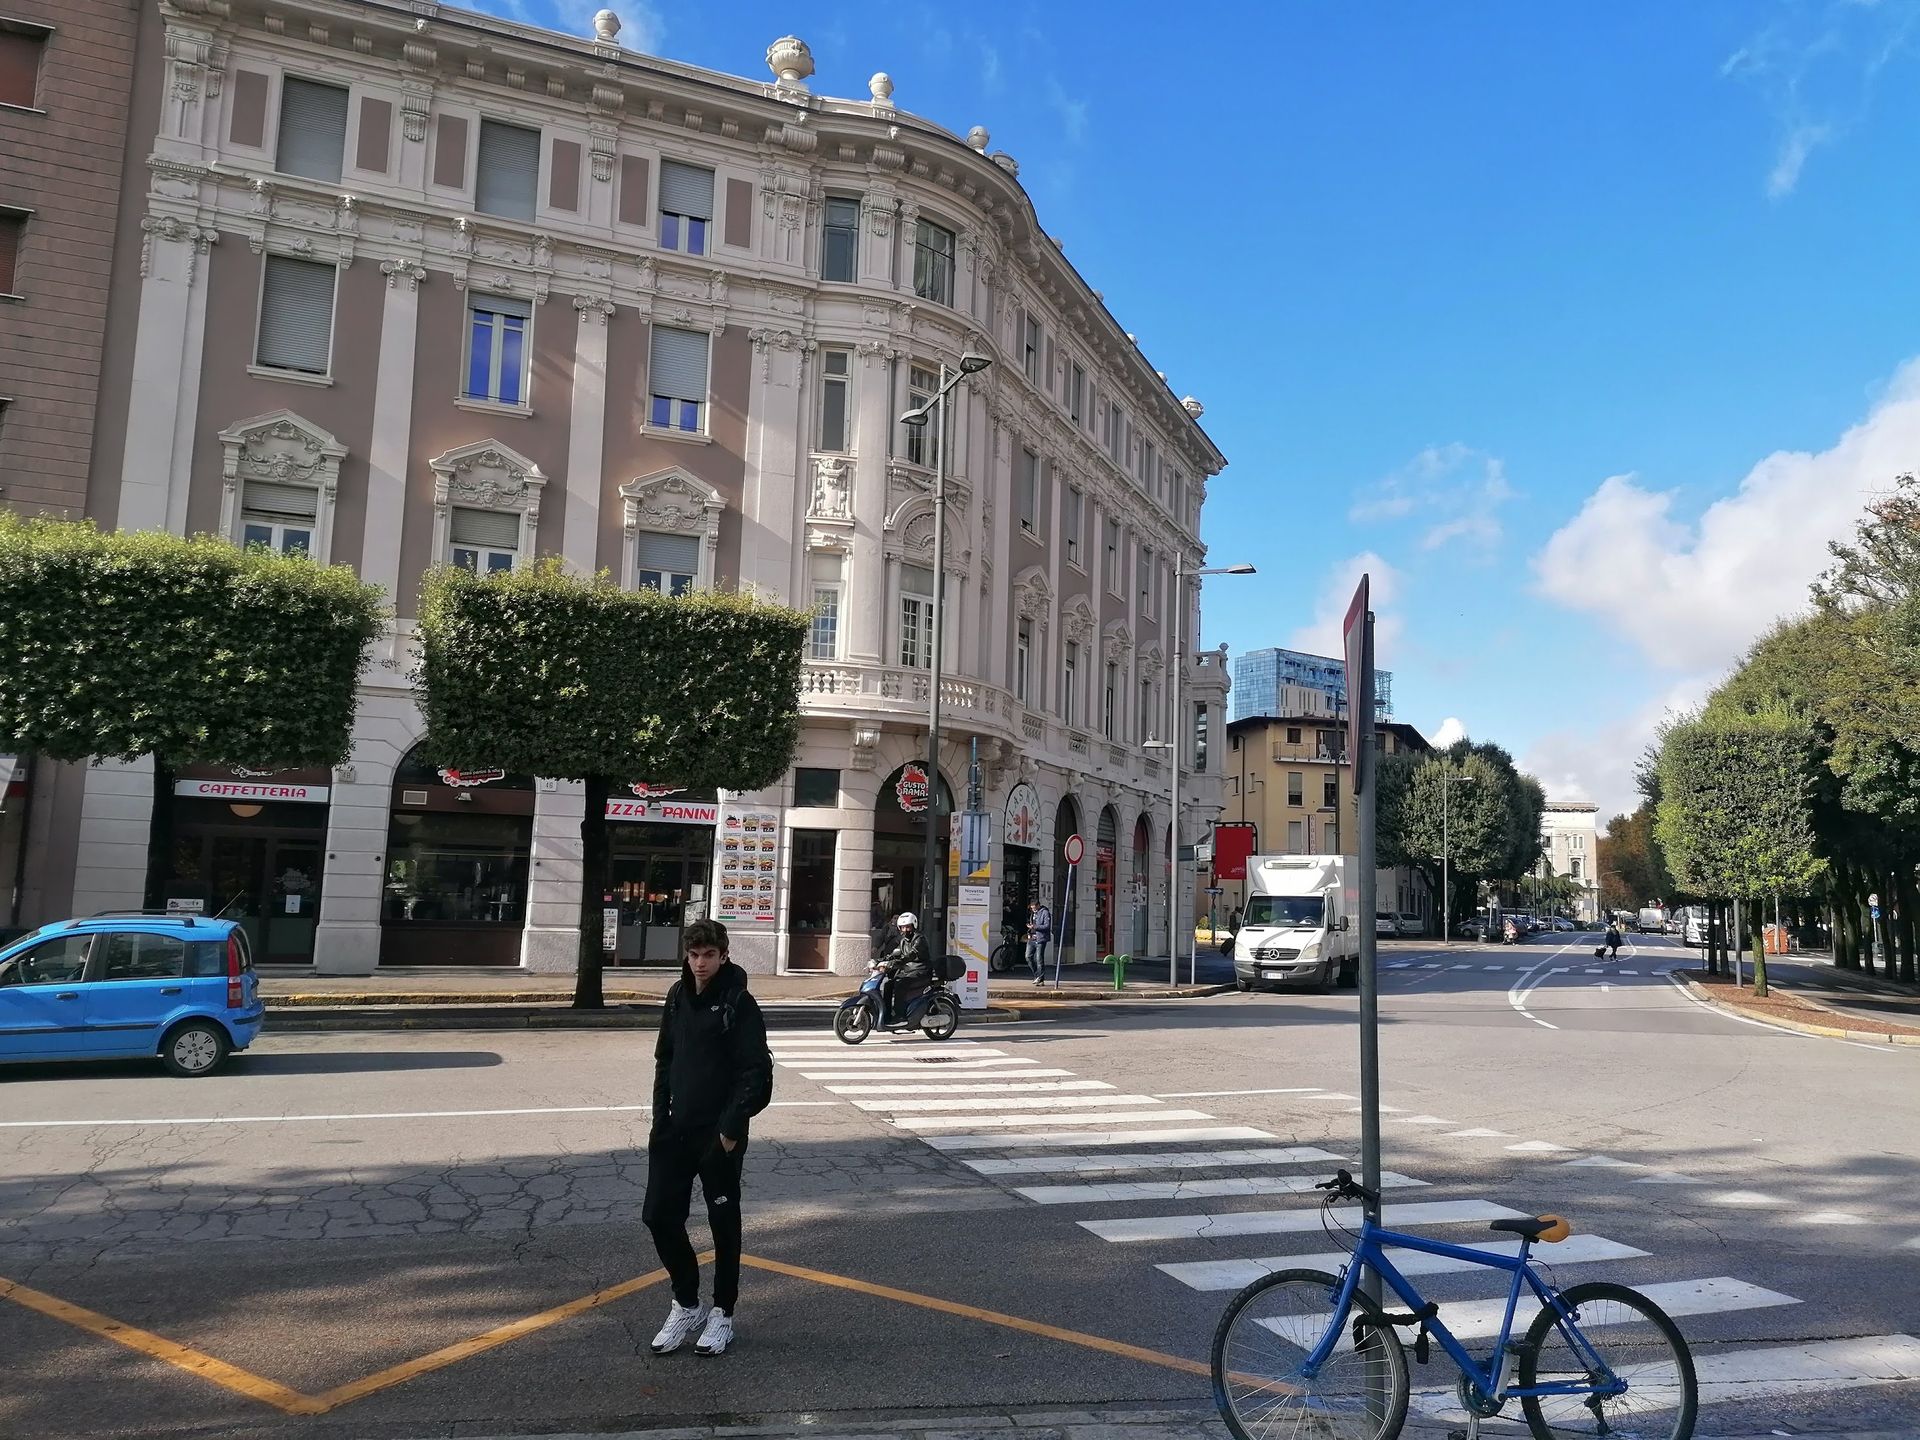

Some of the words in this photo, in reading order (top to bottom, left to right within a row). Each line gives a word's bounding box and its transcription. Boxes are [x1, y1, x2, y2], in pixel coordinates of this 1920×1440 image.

[199, 784, 306, 797] CAFFETTERIA
[903, 781, 926, 790] GUSTO
[902, 788, 926, 797] RAMA
[605, 803, 646, 817] IZZA
[662, 806, 716, 820] PANINI
